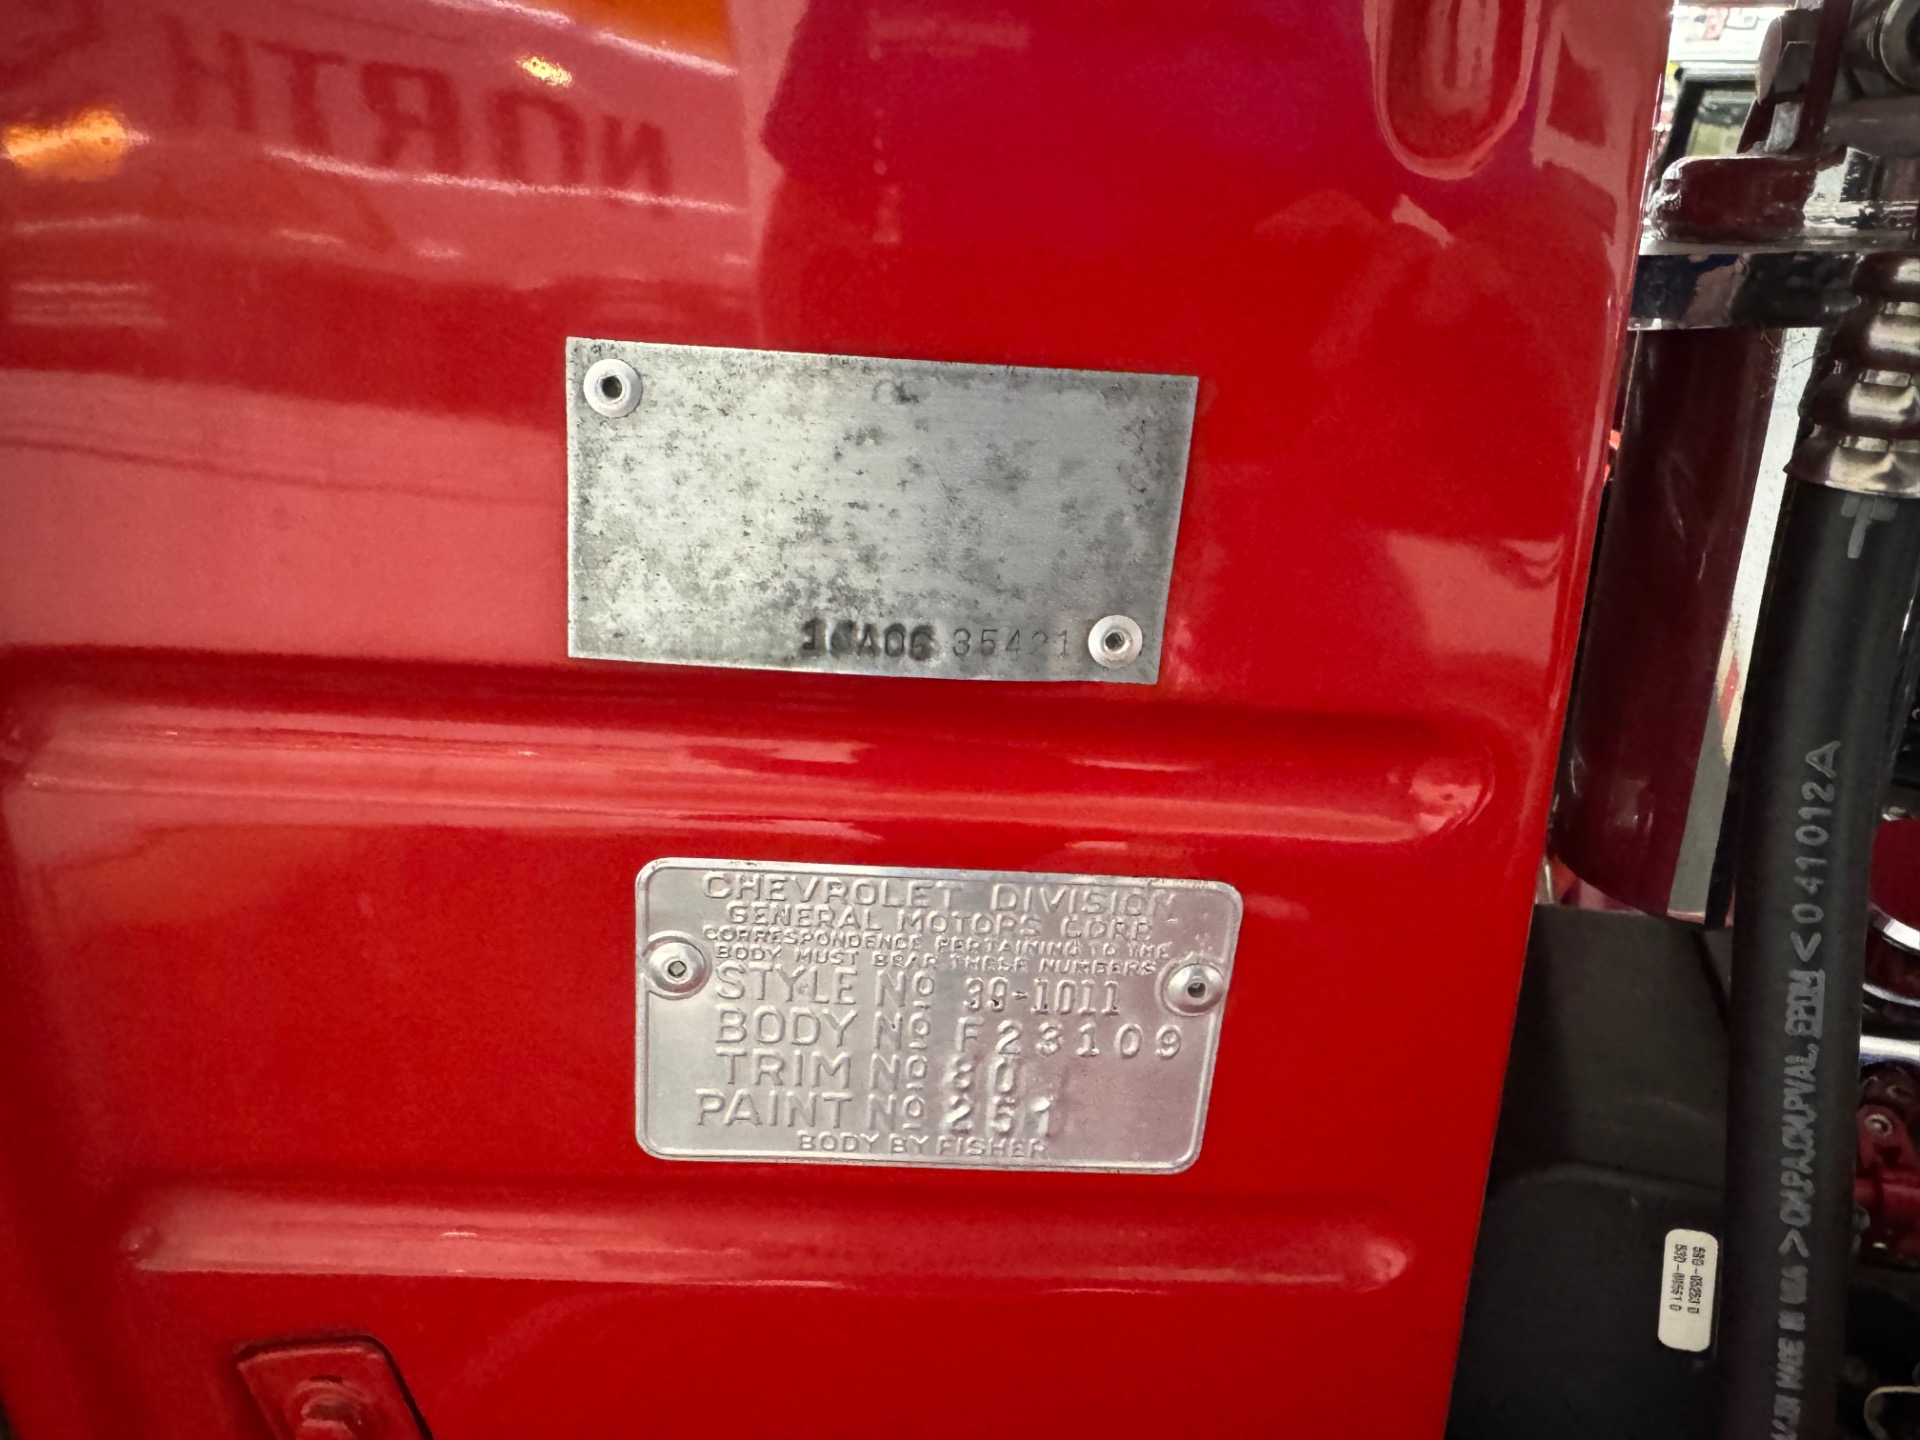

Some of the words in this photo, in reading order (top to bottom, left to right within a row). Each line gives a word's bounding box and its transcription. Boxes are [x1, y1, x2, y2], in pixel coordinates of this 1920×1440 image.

[702, 871, 960, 911] CHEVROLET
[990, 883, 1177, 917] DIVISION
[726, 901, 882, 931] GENERAL
[897, 909, 1042, 937] MOTORS
[702, 924, 923, 950] CORRESPONDENCE
[935, 935, 1081, 957] PERTAINING
[1089, 942, 1117, 957] TO
[1127, 941, 1173, 960] THE
[714, 942, 782, 960] BODY
[794, 947, 859, 965] MUST
[872, 950, 937, 969] BEAR
[949, 953, 1029, 973] THESE
[1038, 957, 1157, 976] NUMBERS
[714, 961, 858, 1006] STYLE
[962, 976, 1120, 1016] 39-1011
[714, 1003, 857, 1048] BODY
[714, 1046, 852, 1089] TRIM
[694, 1088, 853, 1130] PAINT
[796, 1130, 880, 1152] BODY
[889, 1133, 929, 1154] BY
[936, 1136, 1047, 1159] FISHER
